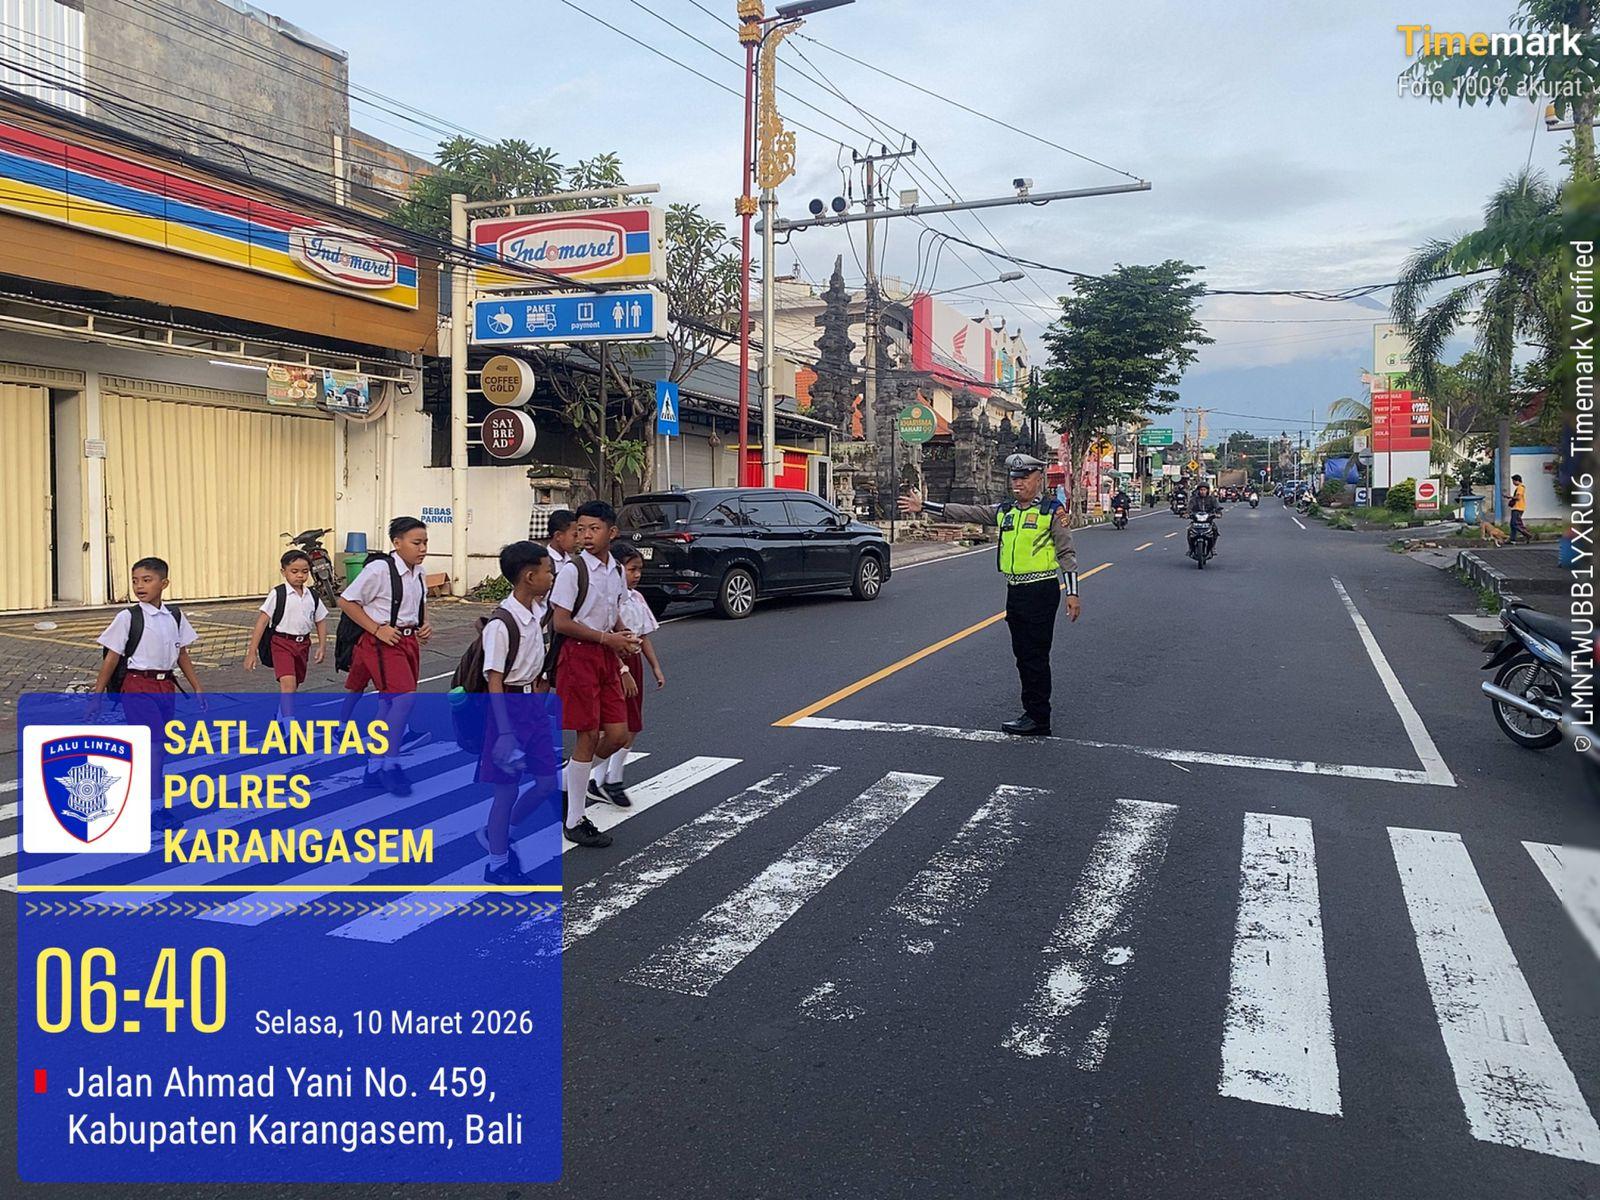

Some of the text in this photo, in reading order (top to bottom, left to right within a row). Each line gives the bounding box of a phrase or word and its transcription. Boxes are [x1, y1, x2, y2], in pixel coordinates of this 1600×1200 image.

[510, 235, 615, 263] Indomaret
[308, 237, 391, 278] Indomaret
[526, 303, 557, 313] PAKET
[571, 321, 601, 331] payment
[484, 376, 520, 385] COFFEE
[490, 384, 515, 392] GOLD
[492, 419, 515, 429] SAY
[493, 429, 515, 438] BRE
[492, 439, 508, 448] AD
[422, 507, 452, 516] BEBAS
[420, 515, 453, 524] PARKIR
